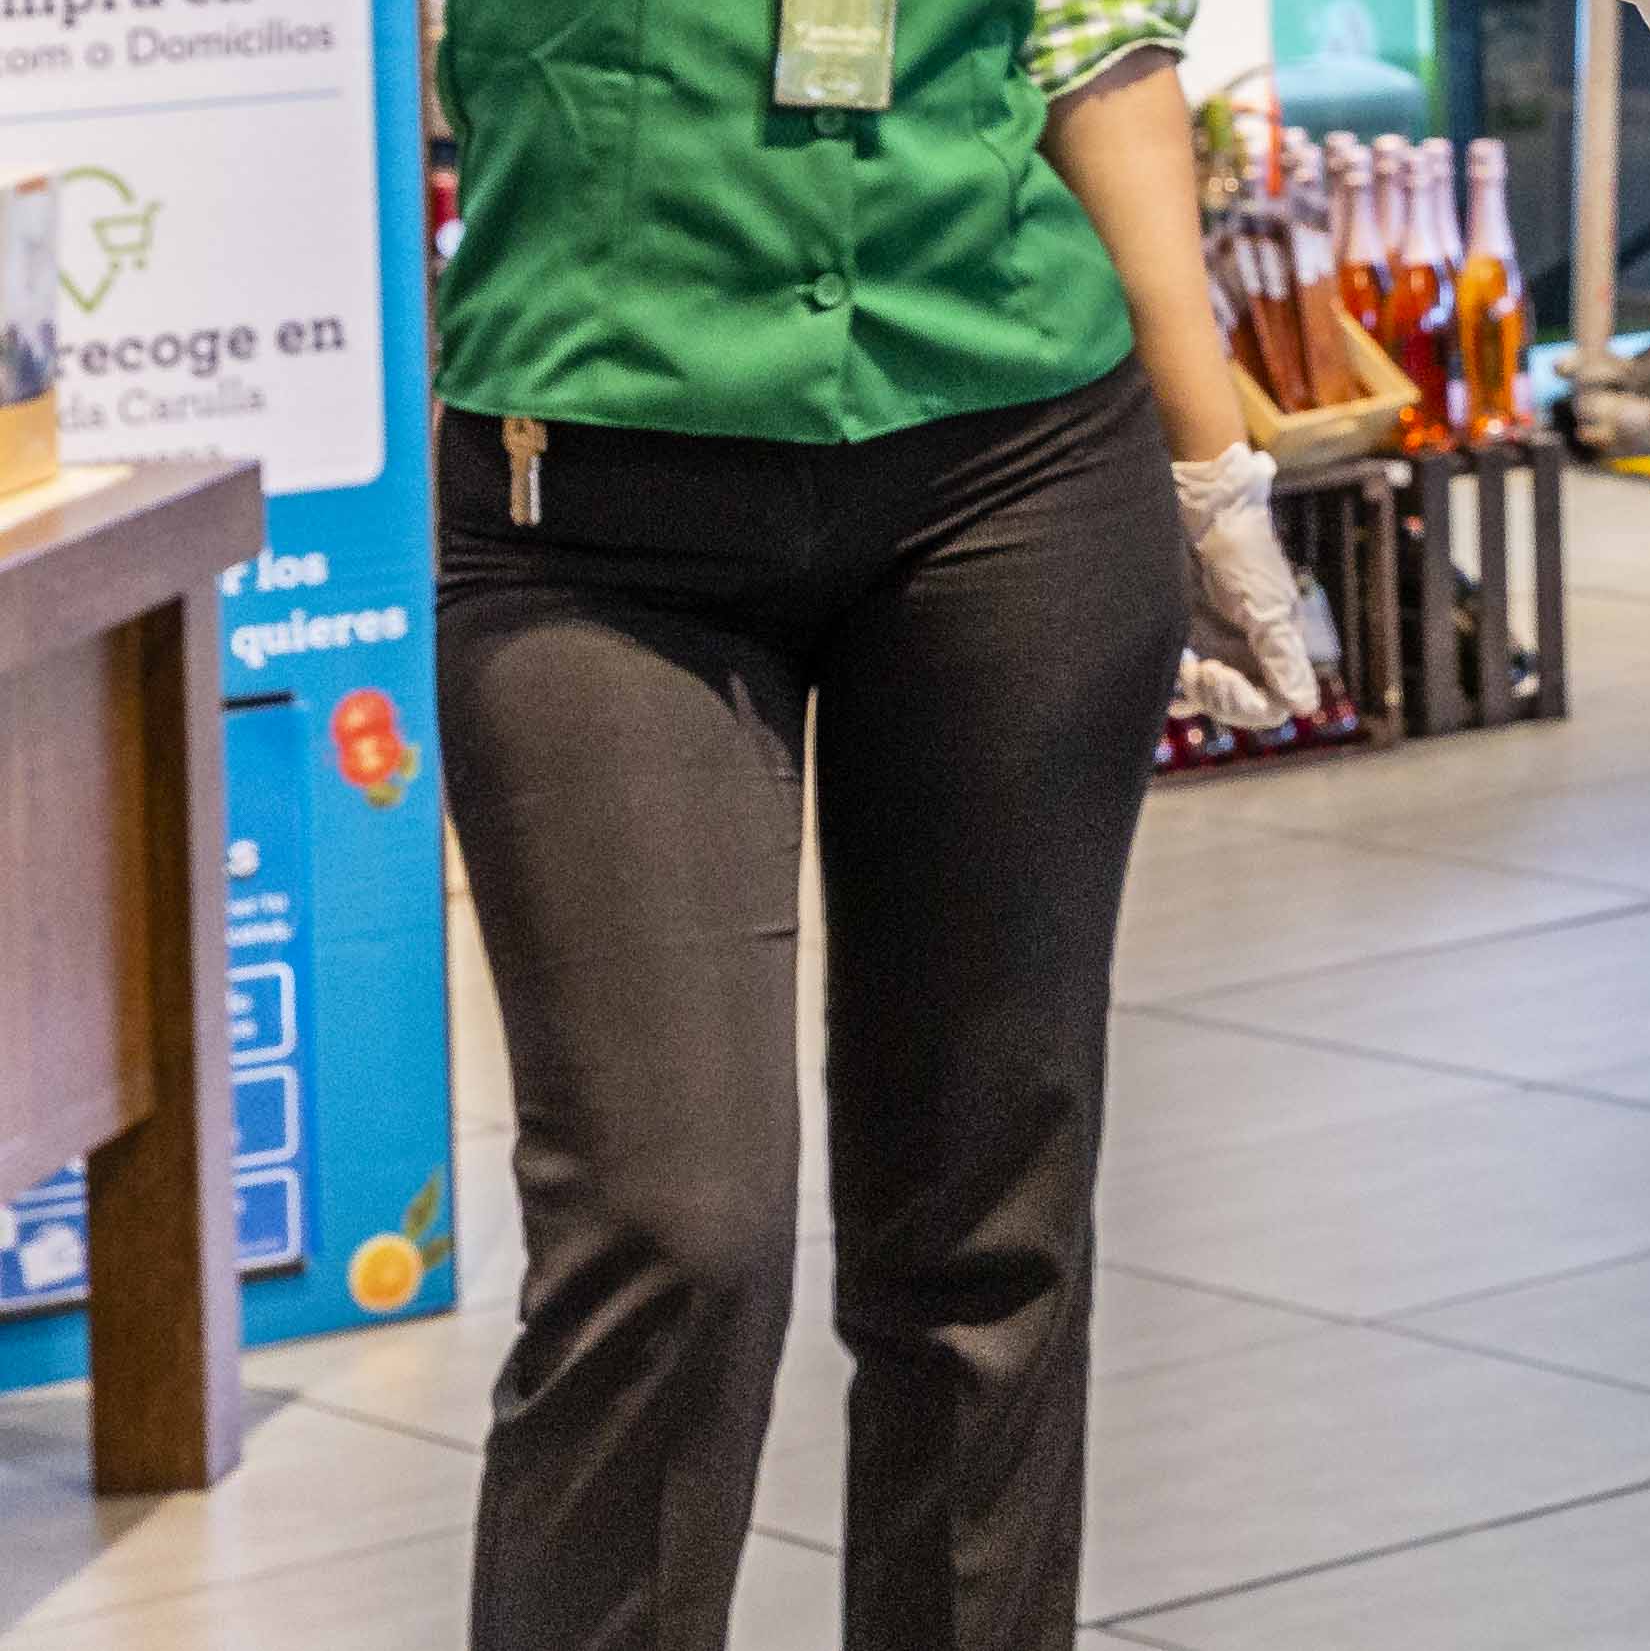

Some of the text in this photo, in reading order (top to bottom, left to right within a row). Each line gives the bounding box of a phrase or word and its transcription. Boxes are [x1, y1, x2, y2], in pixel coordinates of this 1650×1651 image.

[86, 40, 113, 66] o
[126, 16, 333, 63] Domicilios
[277, 315, 344, 355] en
[117, 375, 264, 426] Carulla
[257, 549, 328, 591] los
[231, 607, 407, 669] quieres
